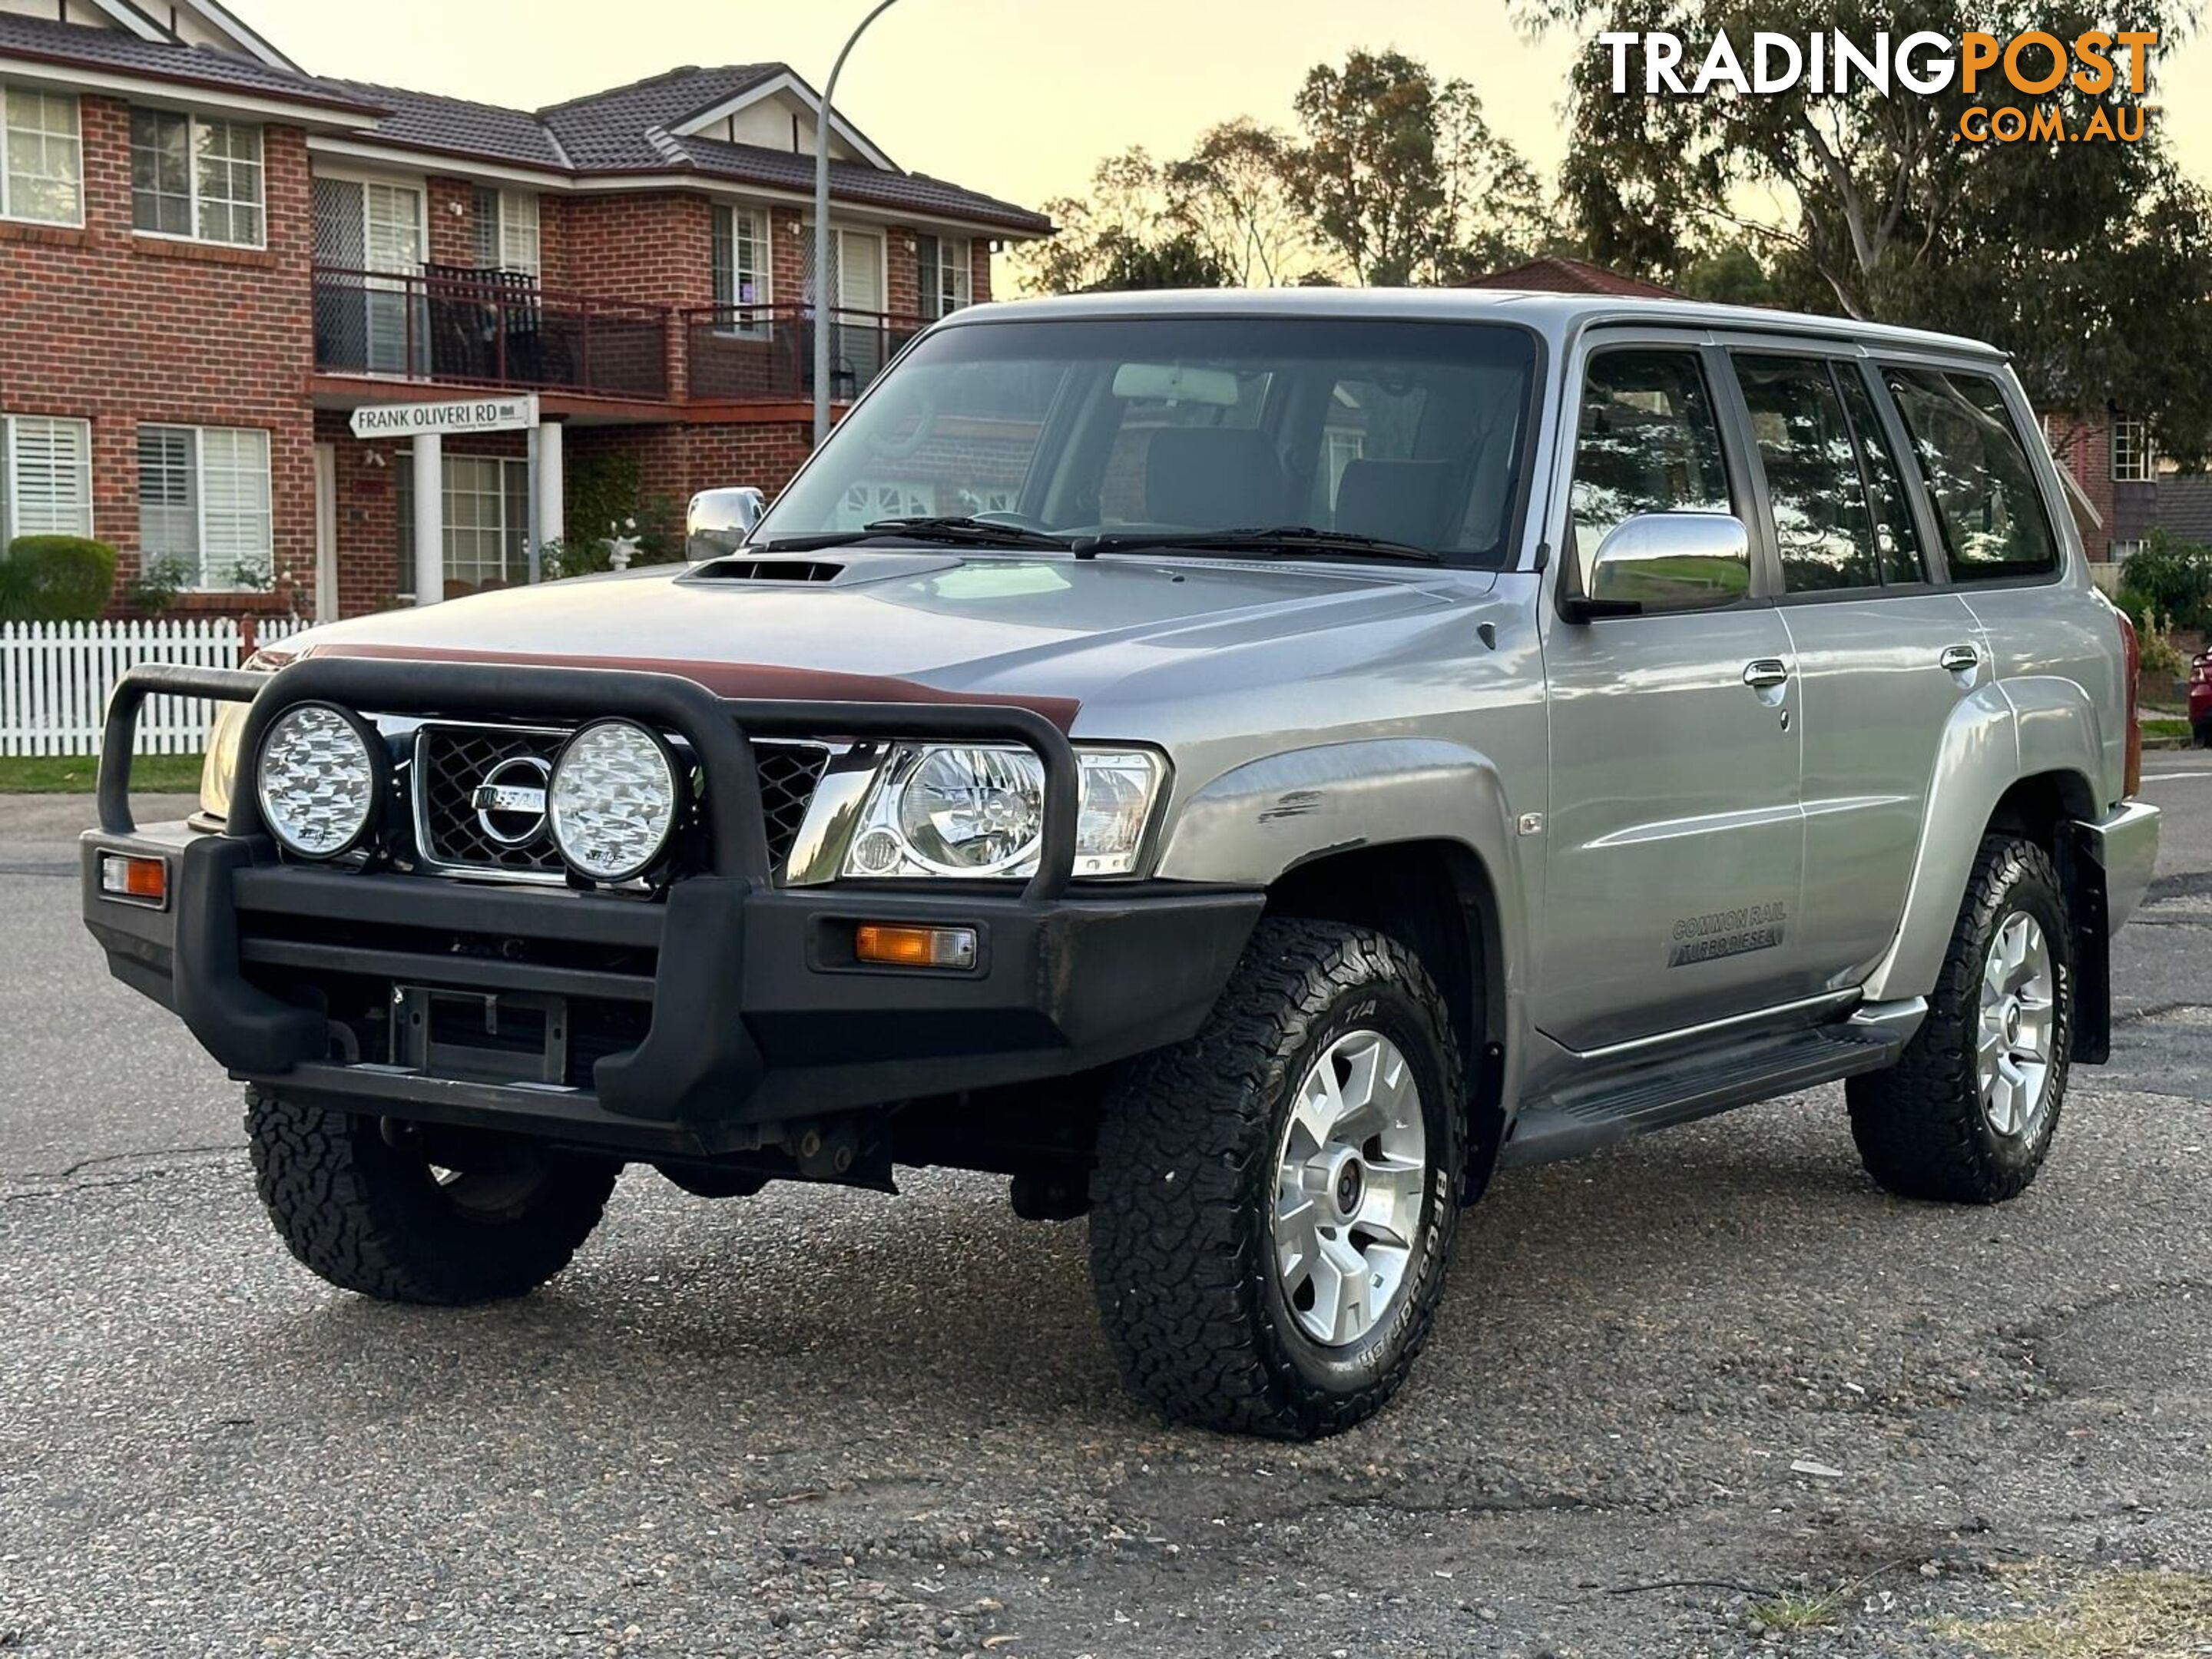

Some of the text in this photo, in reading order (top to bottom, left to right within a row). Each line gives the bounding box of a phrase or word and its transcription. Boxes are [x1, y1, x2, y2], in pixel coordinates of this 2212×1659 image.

[358, 404, 497, 429] FRANK OLIVERI RD
[1673, 902, 1786, 940] COMMON RAIL
[1346, 1000, 1376, 1023] T/A
[1359, 1167, 1449, 1367] BFGoodrich
